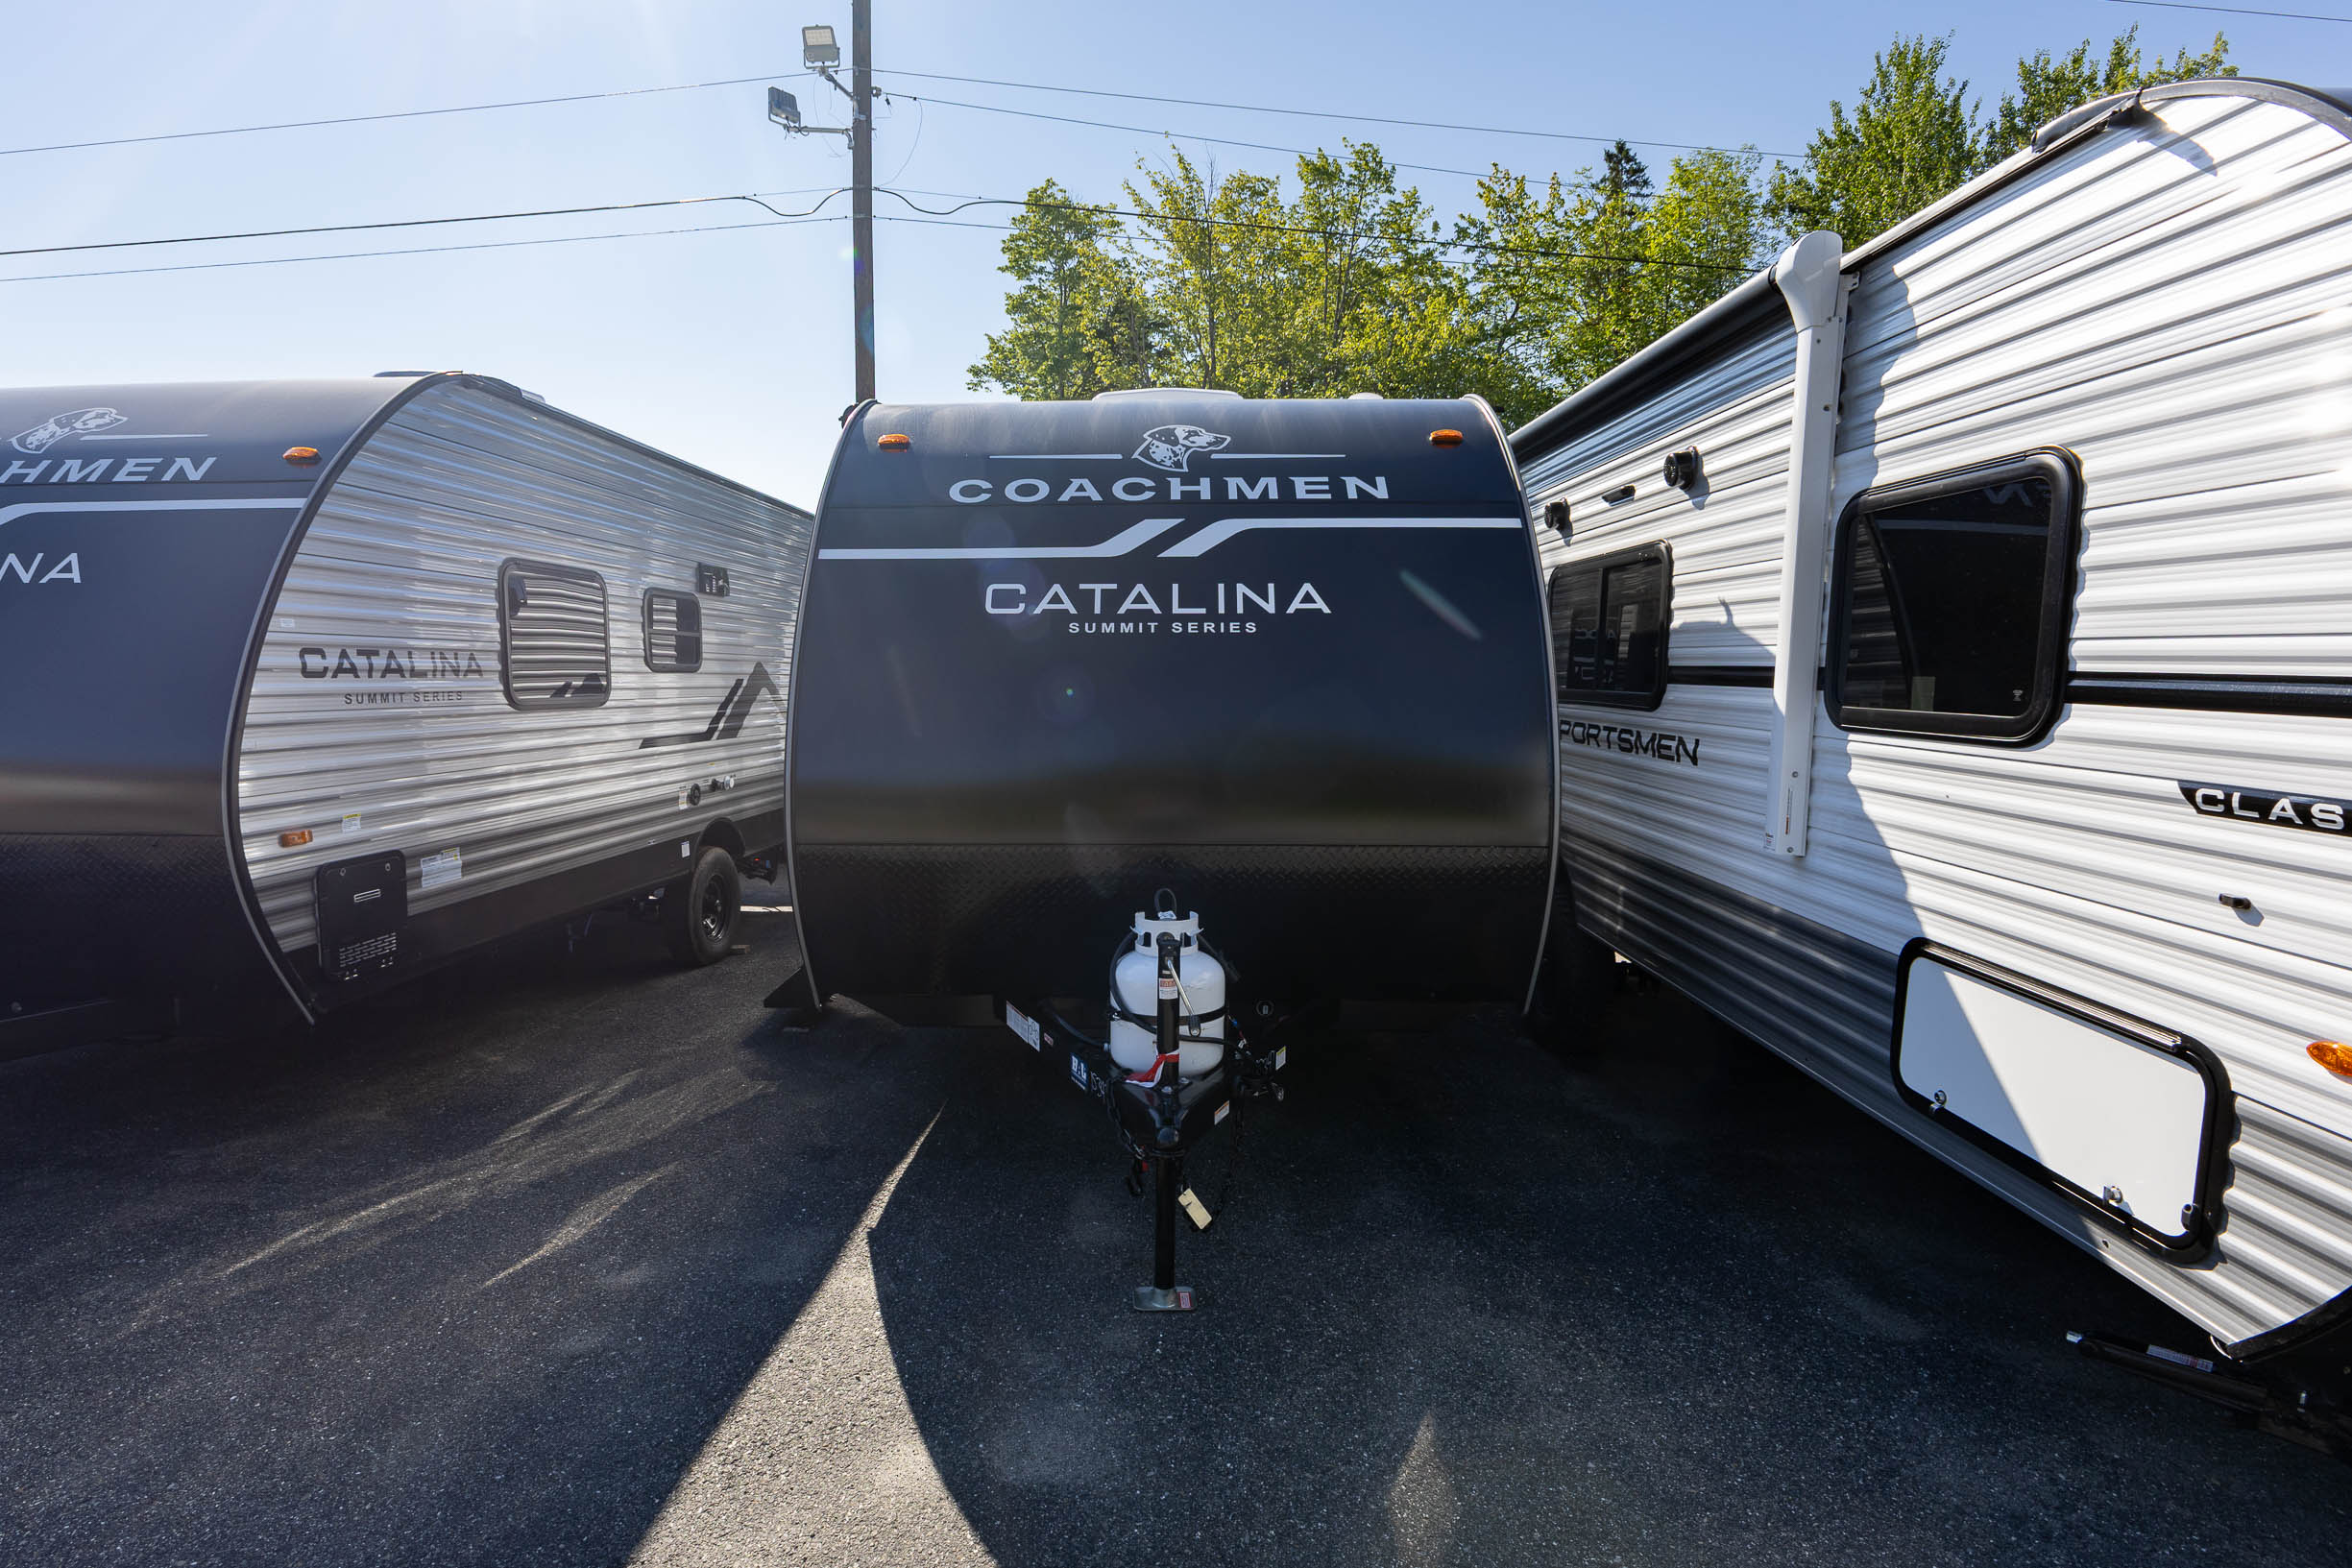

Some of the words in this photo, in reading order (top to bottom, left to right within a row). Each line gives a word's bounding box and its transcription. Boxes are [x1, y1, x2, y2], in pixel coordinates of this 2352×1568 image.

[947, 475, 1391, 504] COACHMEN
[983, 582, 1333, 615] CATALINA
[1068, 621, 1159, 634] SUMMIT
[1171, 621, 1258, 634] SERIES
[298, 646, 484, 679] CATALINA
[344, 691, 406, 705] SUMMIT
[412, 690, 464, 703] SERIES
[2194, 787, 2345, 831] CLAS
